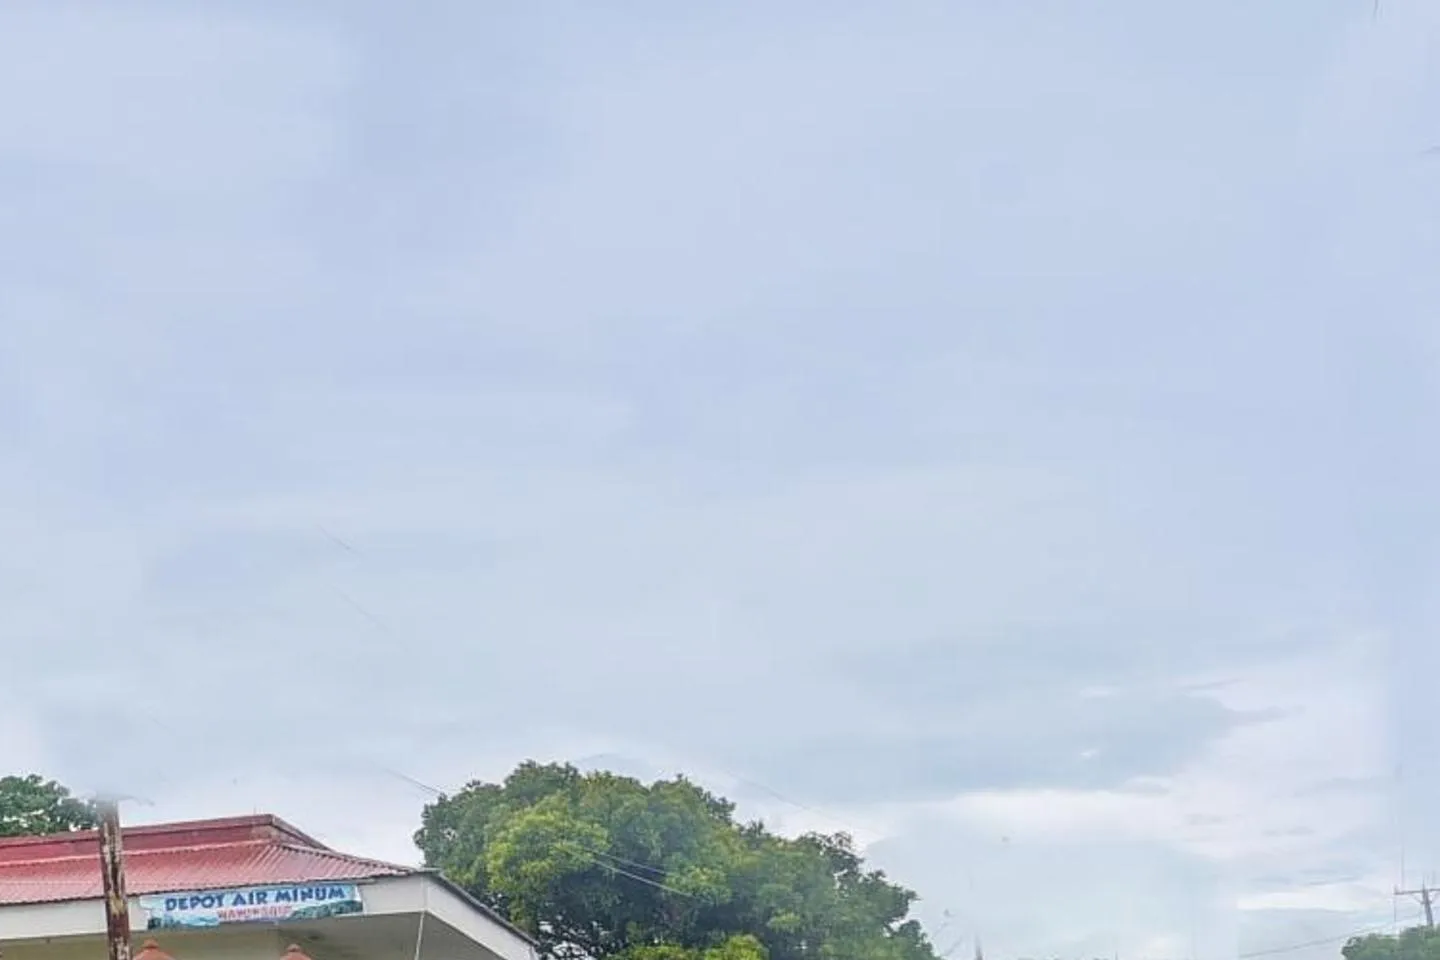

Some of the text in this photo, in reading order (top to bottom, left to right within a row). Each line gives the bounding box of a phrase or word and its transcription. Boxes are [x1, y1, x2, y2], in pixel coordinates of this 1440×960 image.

[165, 887, 345, 911] DEPOT AIR MINUM
